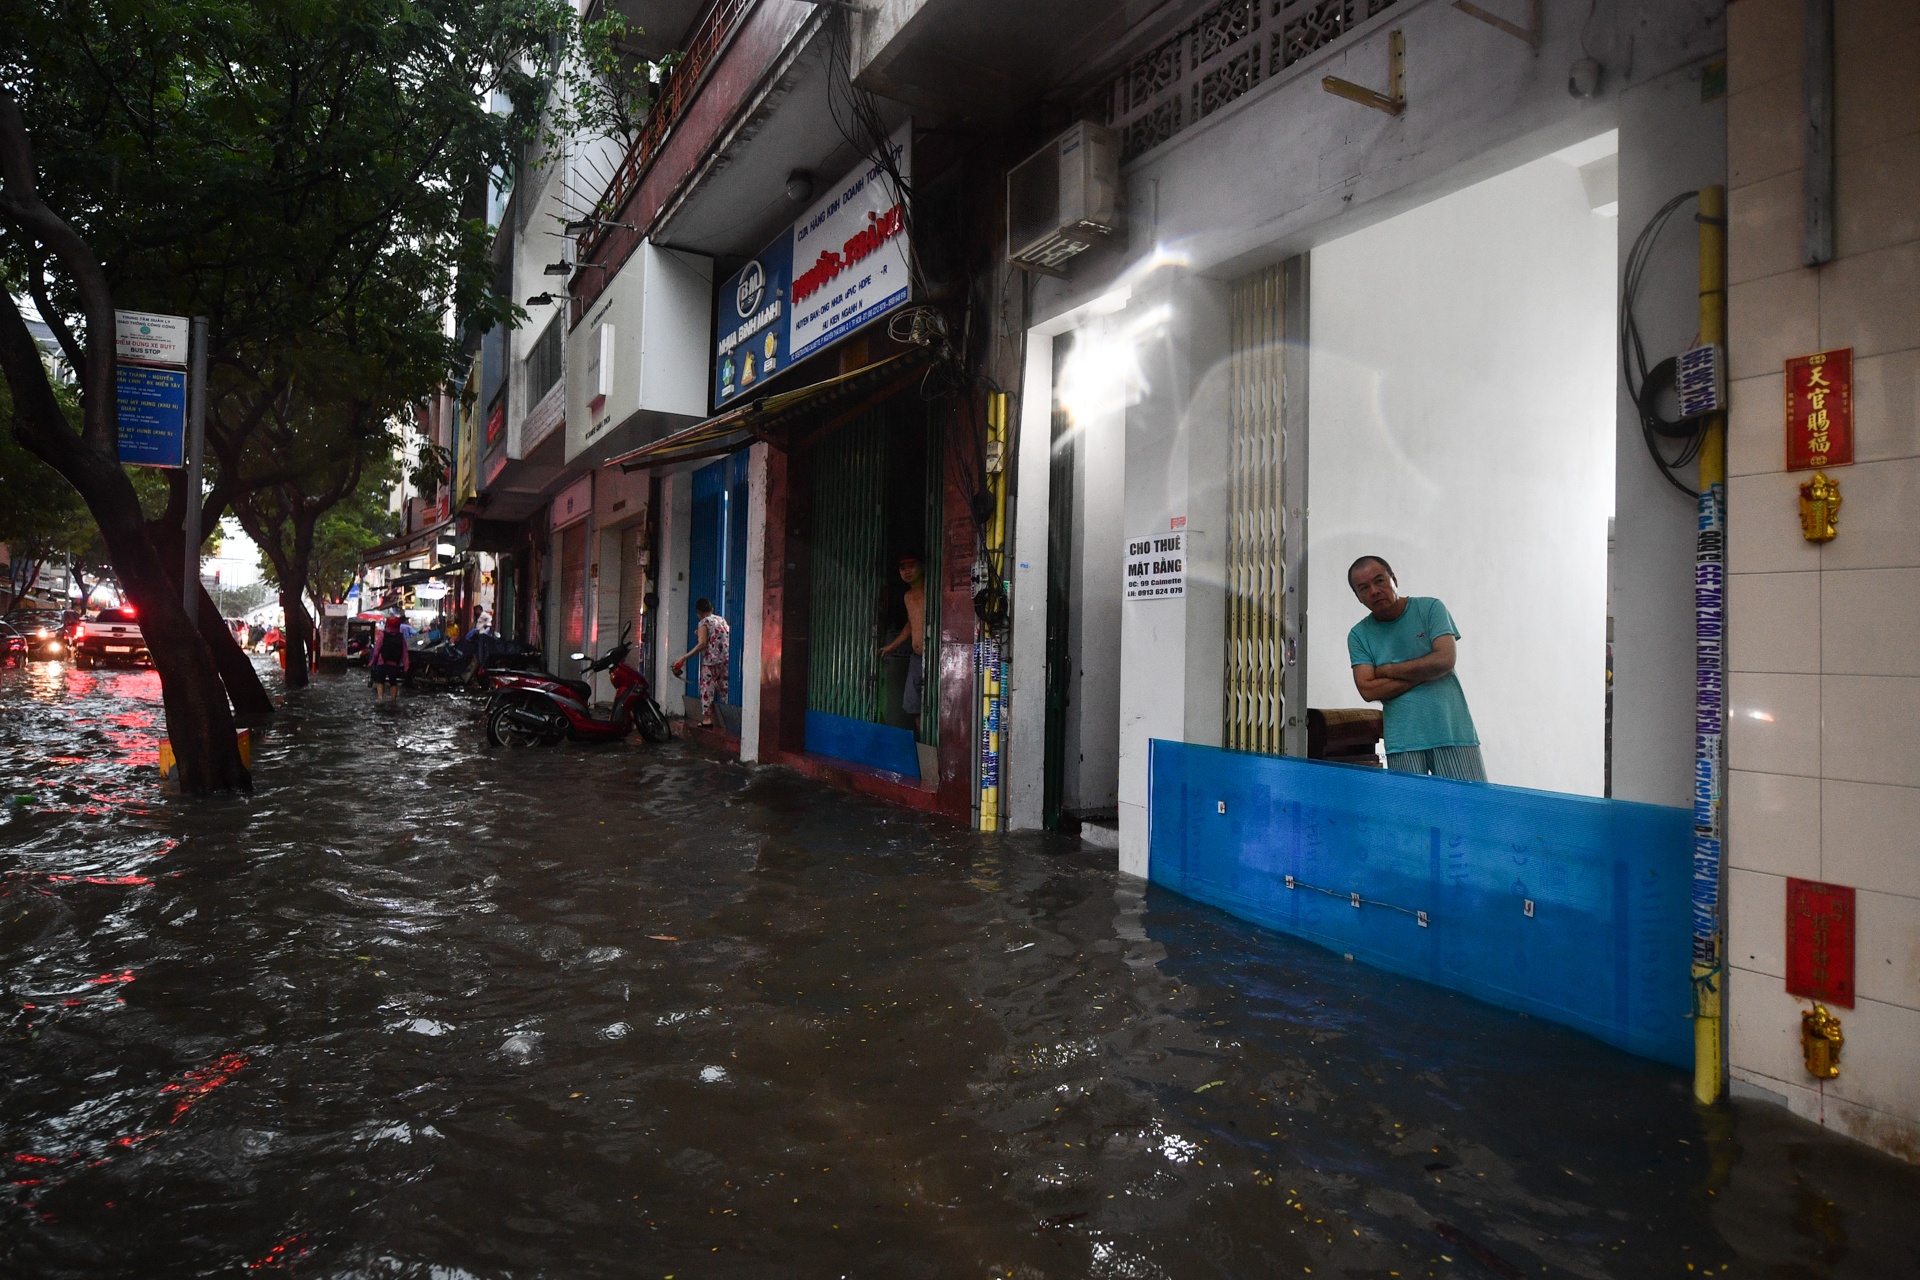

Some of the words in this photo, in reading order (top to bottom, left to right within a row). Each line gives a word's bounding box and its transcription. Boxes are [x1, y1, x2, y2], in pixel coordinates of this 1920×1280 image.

[827, 201, 841, 217] KINH
[843, 178, 864, 204] DOANH
[1807, 366, 1831, 454] 天官賜福
[1129, 541, 1151, 556] CHO
[1153, 534, 1181, 553] THUÊ
[1128, 561, 1150, 578] MẶT
[1153, 556, 1182, 575] BẰNG
[1150, 577, 1182, 586] Calmette
[1137, 588, 1154, 596] 0913
[1695, 565, 1723, 637] 0812.802.555
[1695, 671, 1721, 735] 0934.386.599
